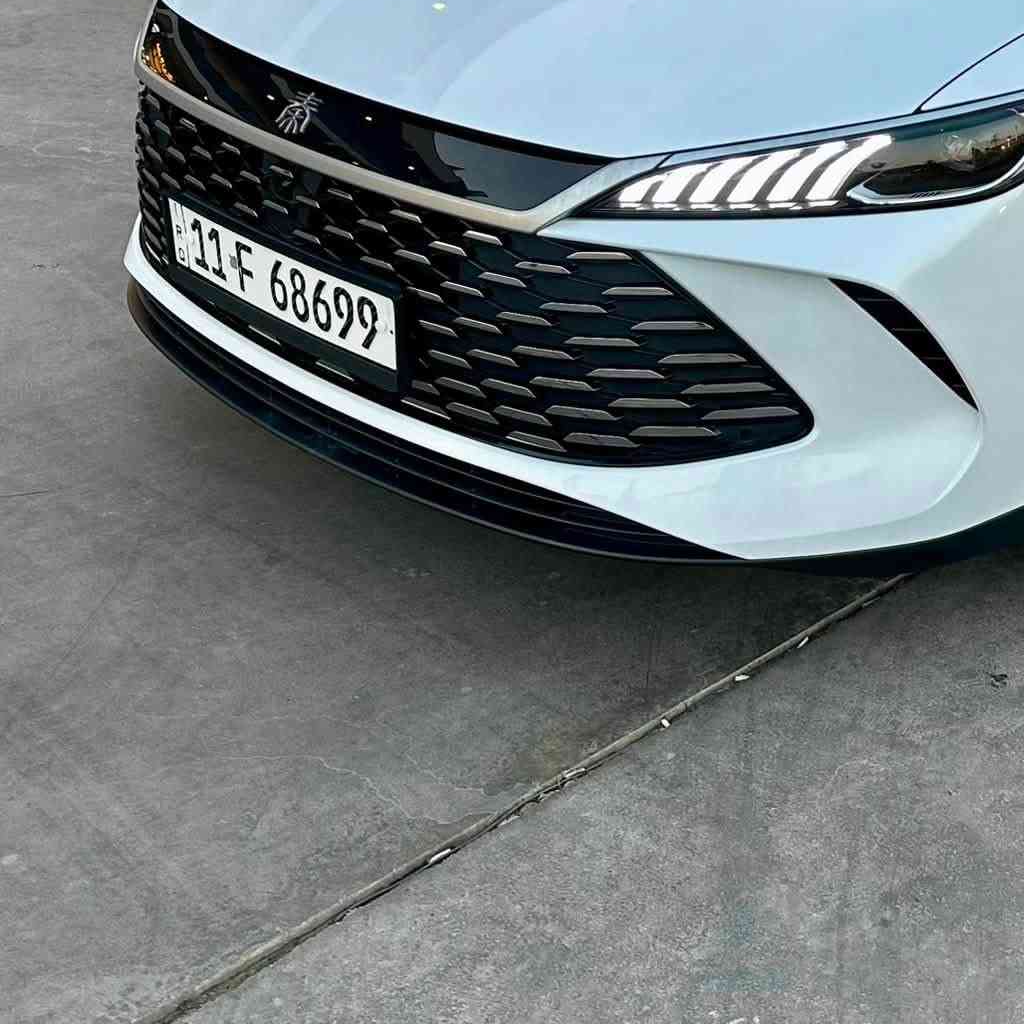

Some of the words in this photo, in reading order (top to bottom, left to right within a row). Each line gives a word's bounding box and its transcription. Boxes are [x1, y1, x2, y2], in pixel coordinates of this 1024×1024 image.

[190, 217, 228, 282] 11
[235, 240, 255, 293] F
[270, 259, 380, 351] 68699
